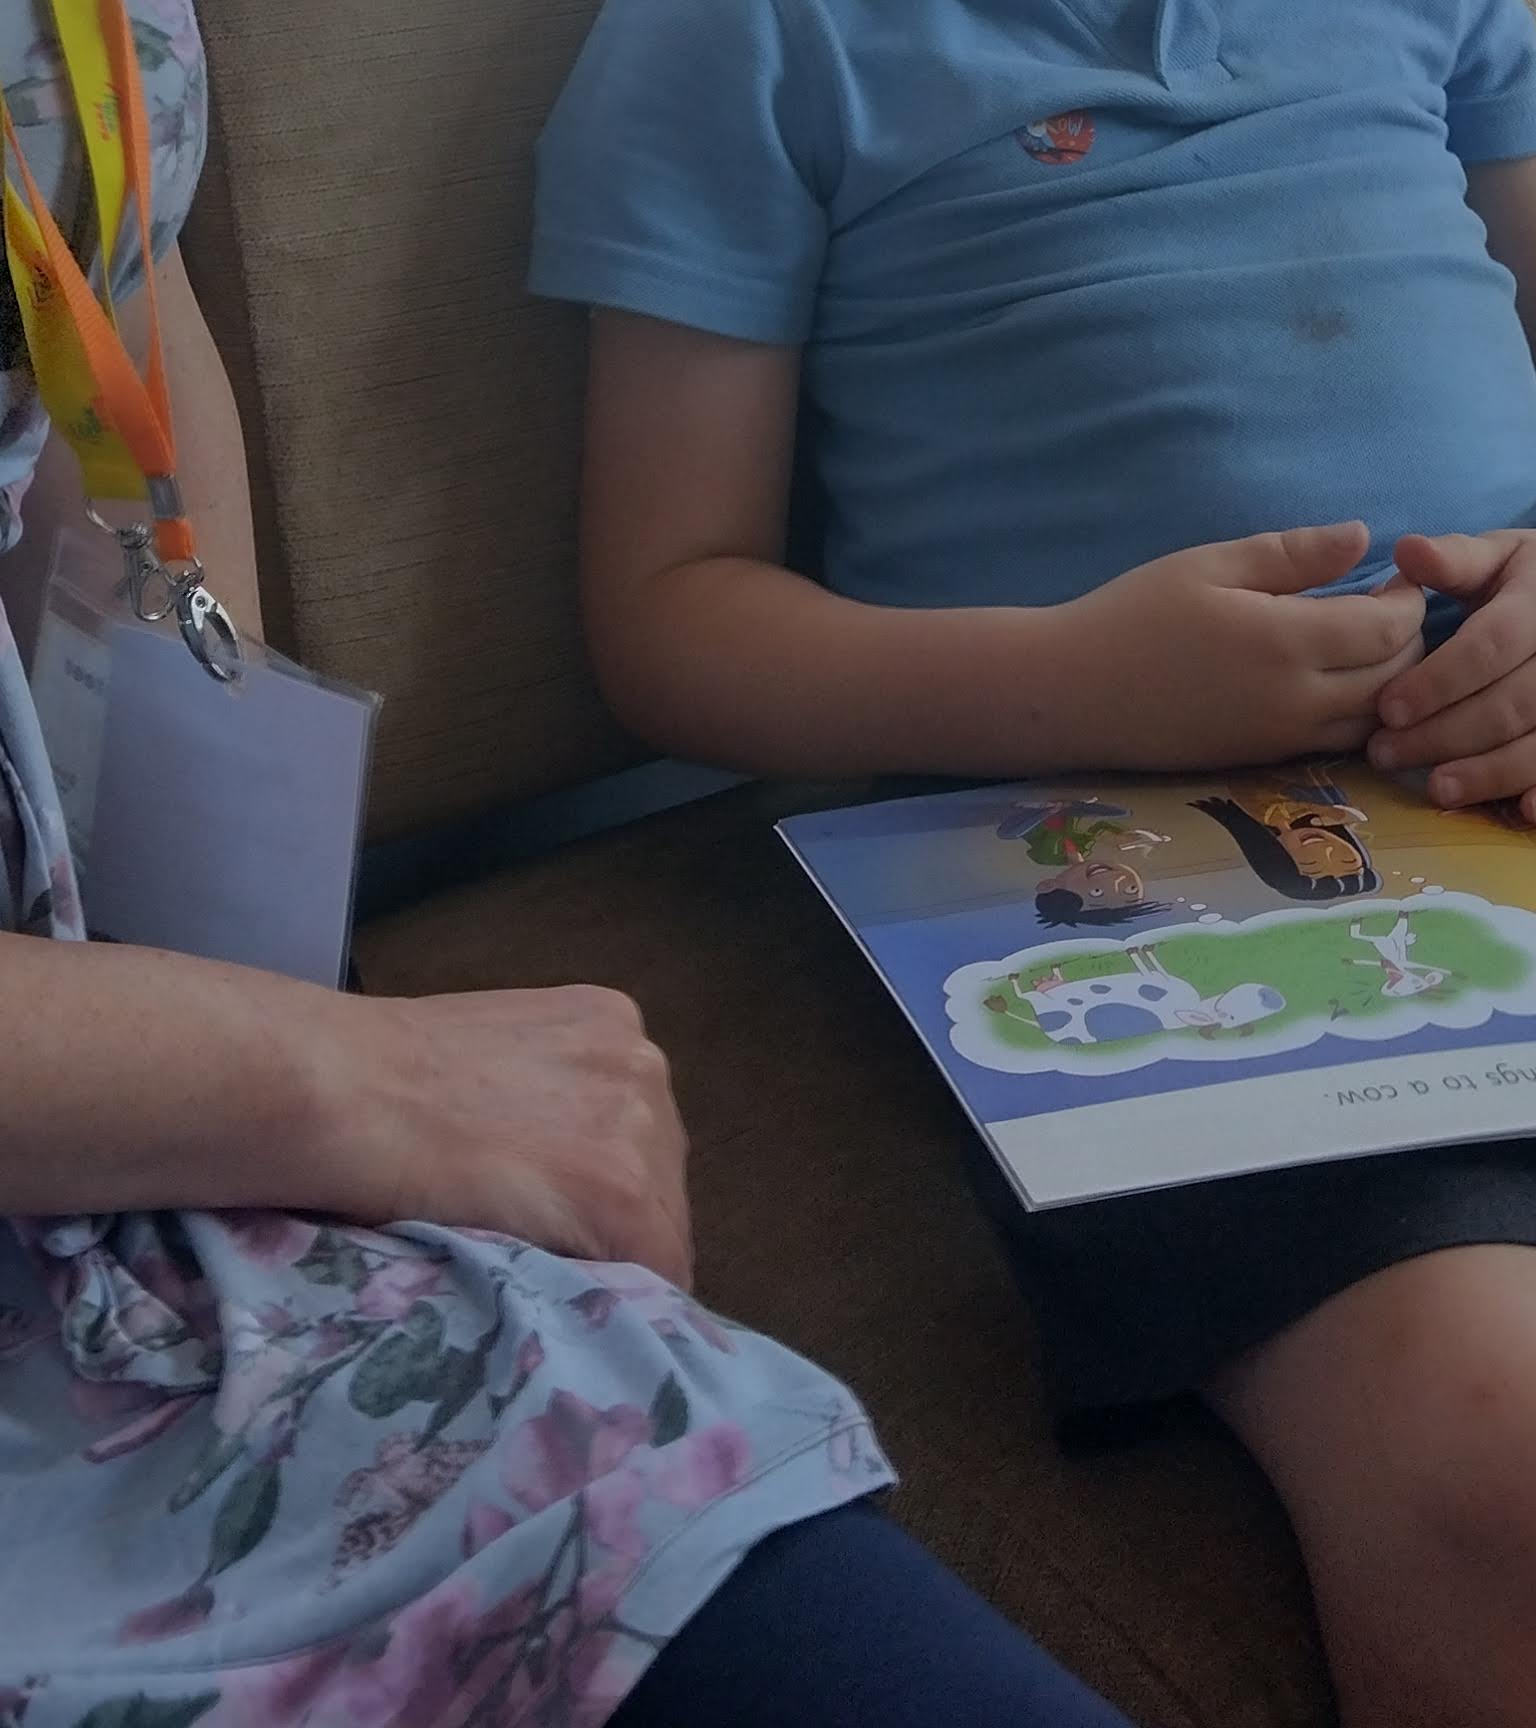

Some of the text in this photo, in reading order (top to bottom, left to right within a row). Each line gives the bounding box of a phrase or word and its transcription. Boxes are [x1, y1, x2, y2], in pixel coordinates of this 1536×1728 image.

[1408, 1078, 1431, 1096] a
[1441, 1074, 1479, 1092] to
[1323, 1082, 1399, 1108] cow.
